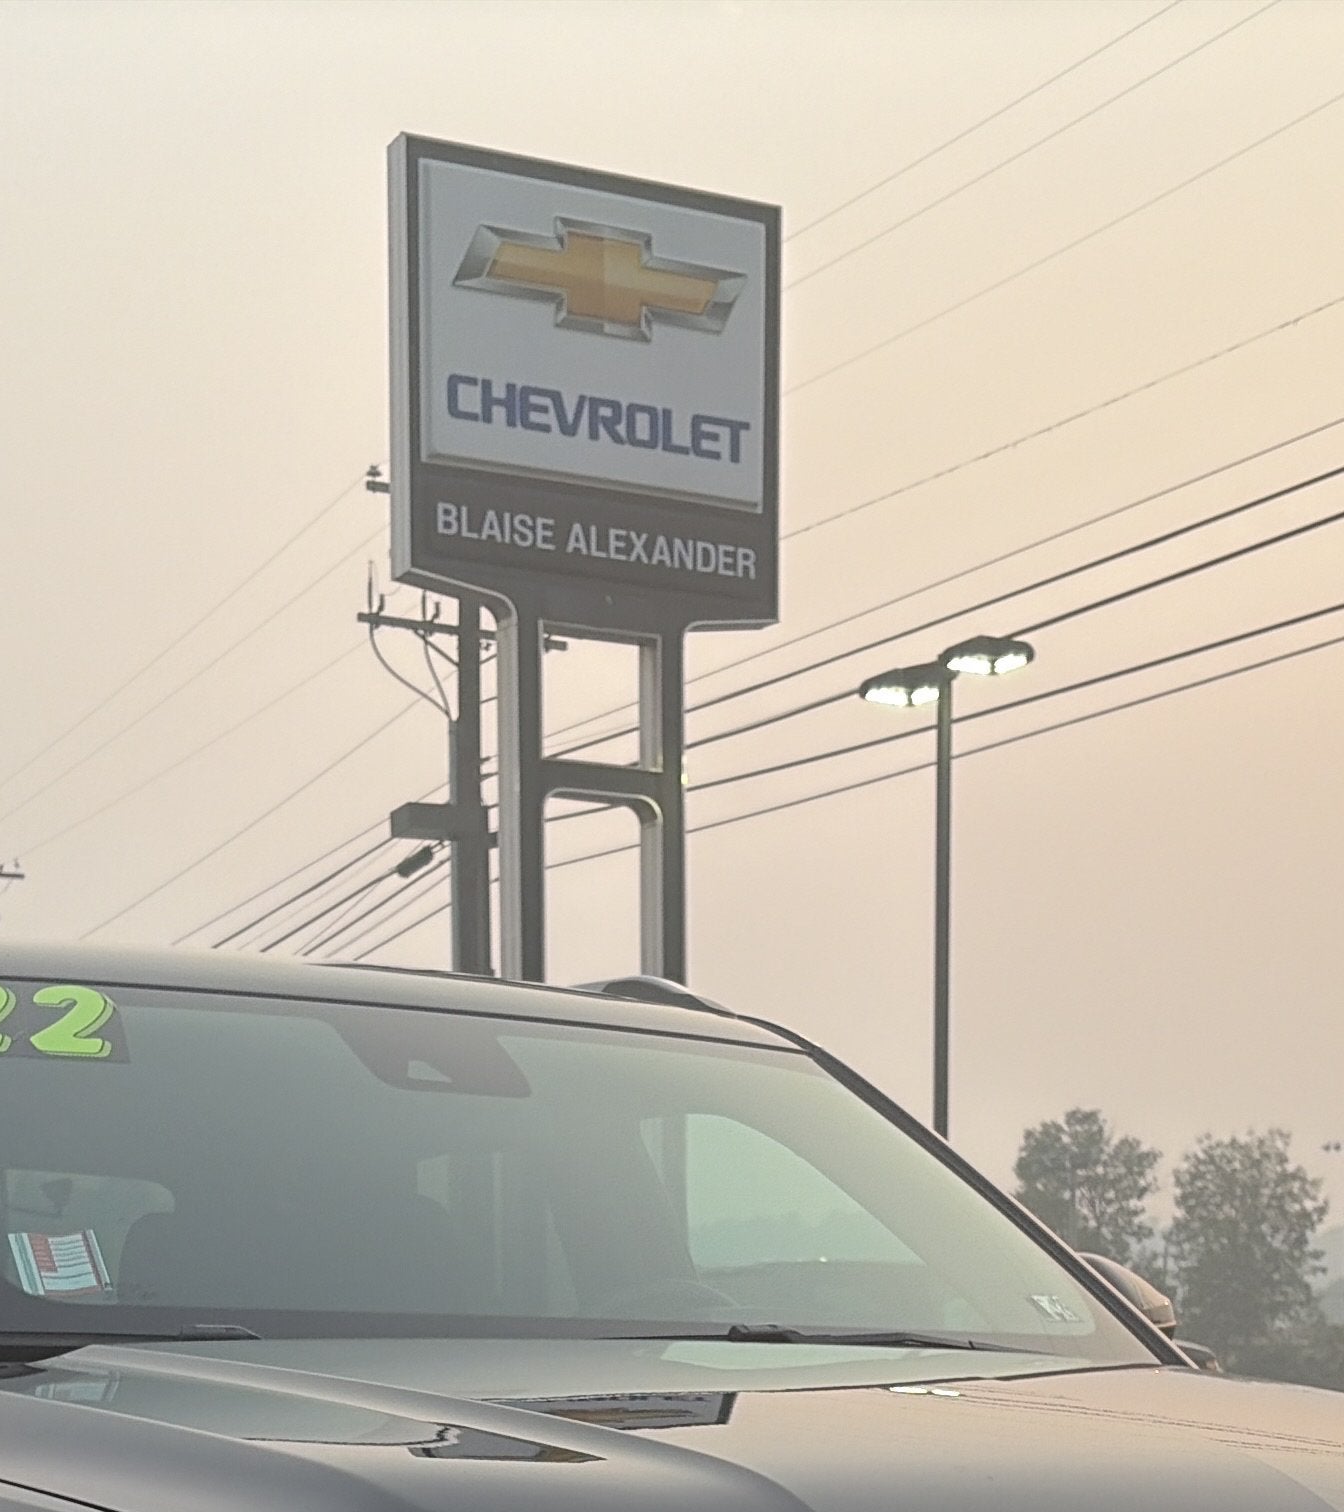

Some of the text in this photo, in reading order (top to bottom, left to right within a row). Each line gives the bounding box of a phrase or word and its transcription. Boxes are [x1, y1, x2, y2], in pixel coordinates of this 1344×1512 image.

[447, 373, 751, 464] CHEVROLET
[436, 502, 757, 580] BLAISE ALEXANDER
